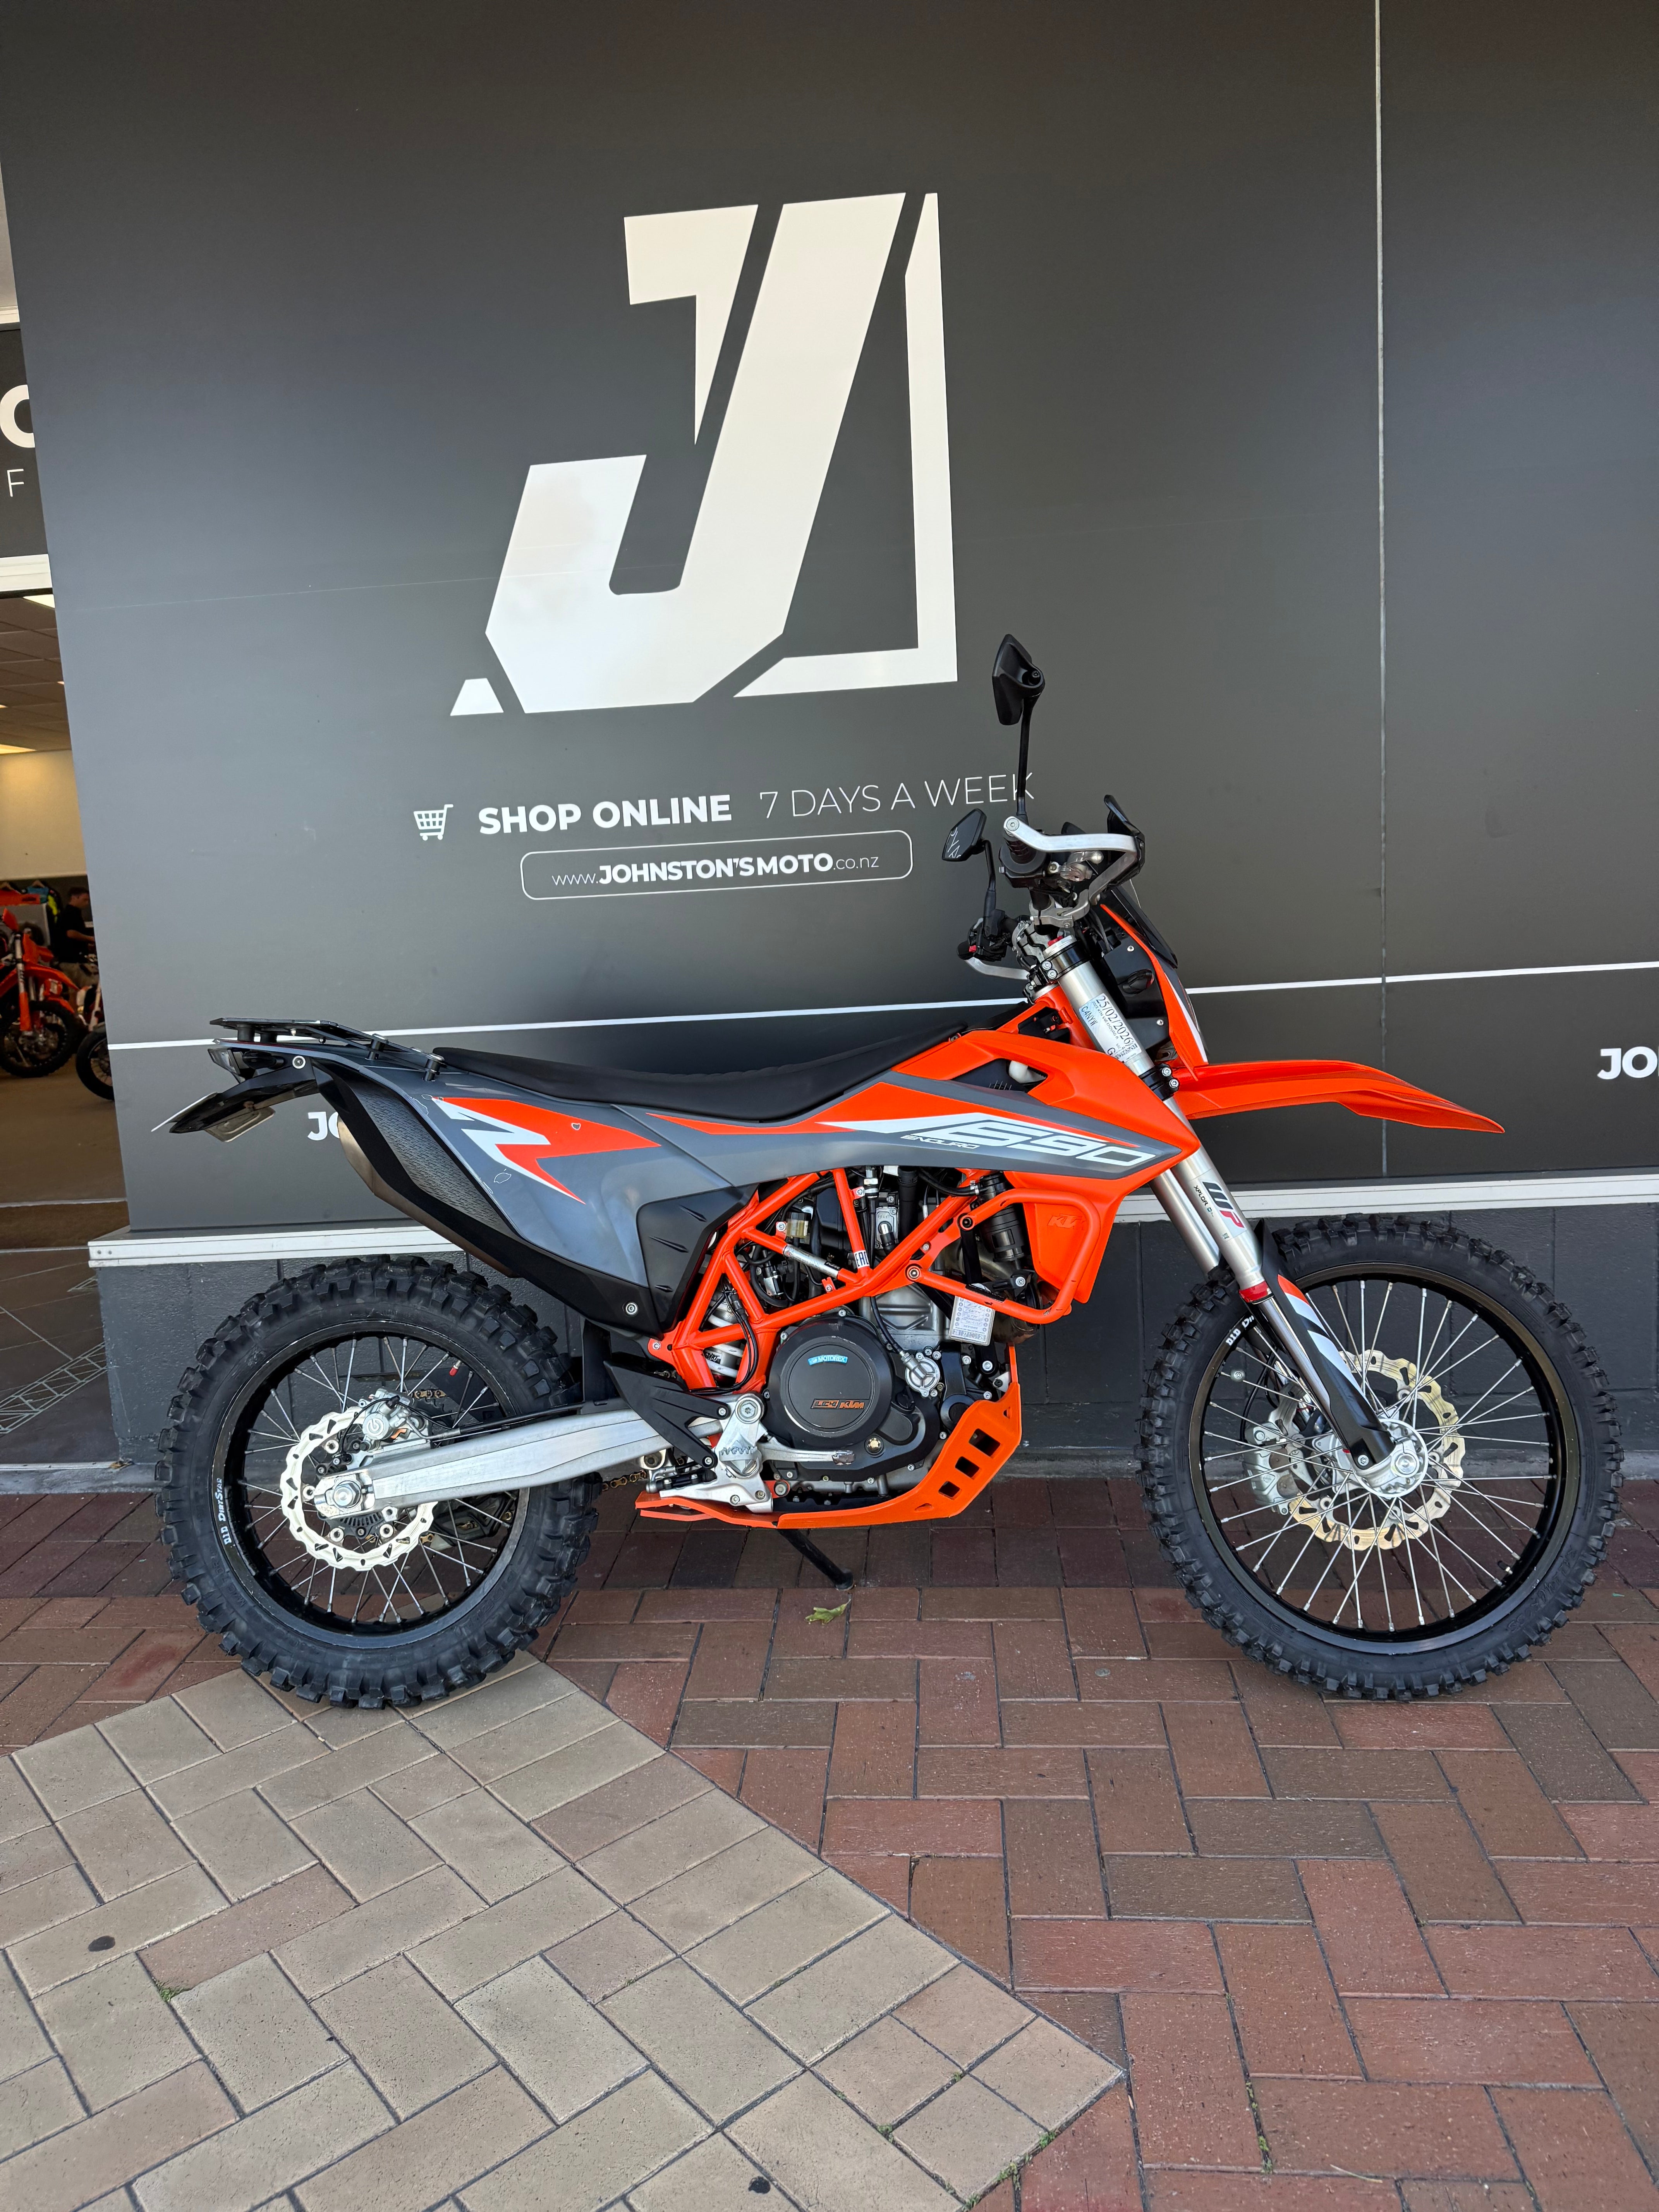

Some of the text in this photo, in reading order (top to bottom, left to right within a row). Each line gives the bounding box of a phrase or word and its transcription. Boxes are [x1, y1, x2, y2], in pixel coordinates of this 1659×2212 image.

[478, 772, 1034, 835] SHOP ONLINE 7 DAYS A WEEK
[1095, 995, 1134, 1044] 25/02/2026
[1597, 1046, 1659, 1080] JO
[900, 1134, 981, 1149] ENDURO
[909, 1121, 1156, 1167] 690
[1194, 1185, 1208, 1206] XPLOR
[839, 1400, 865, 1409] KTM
